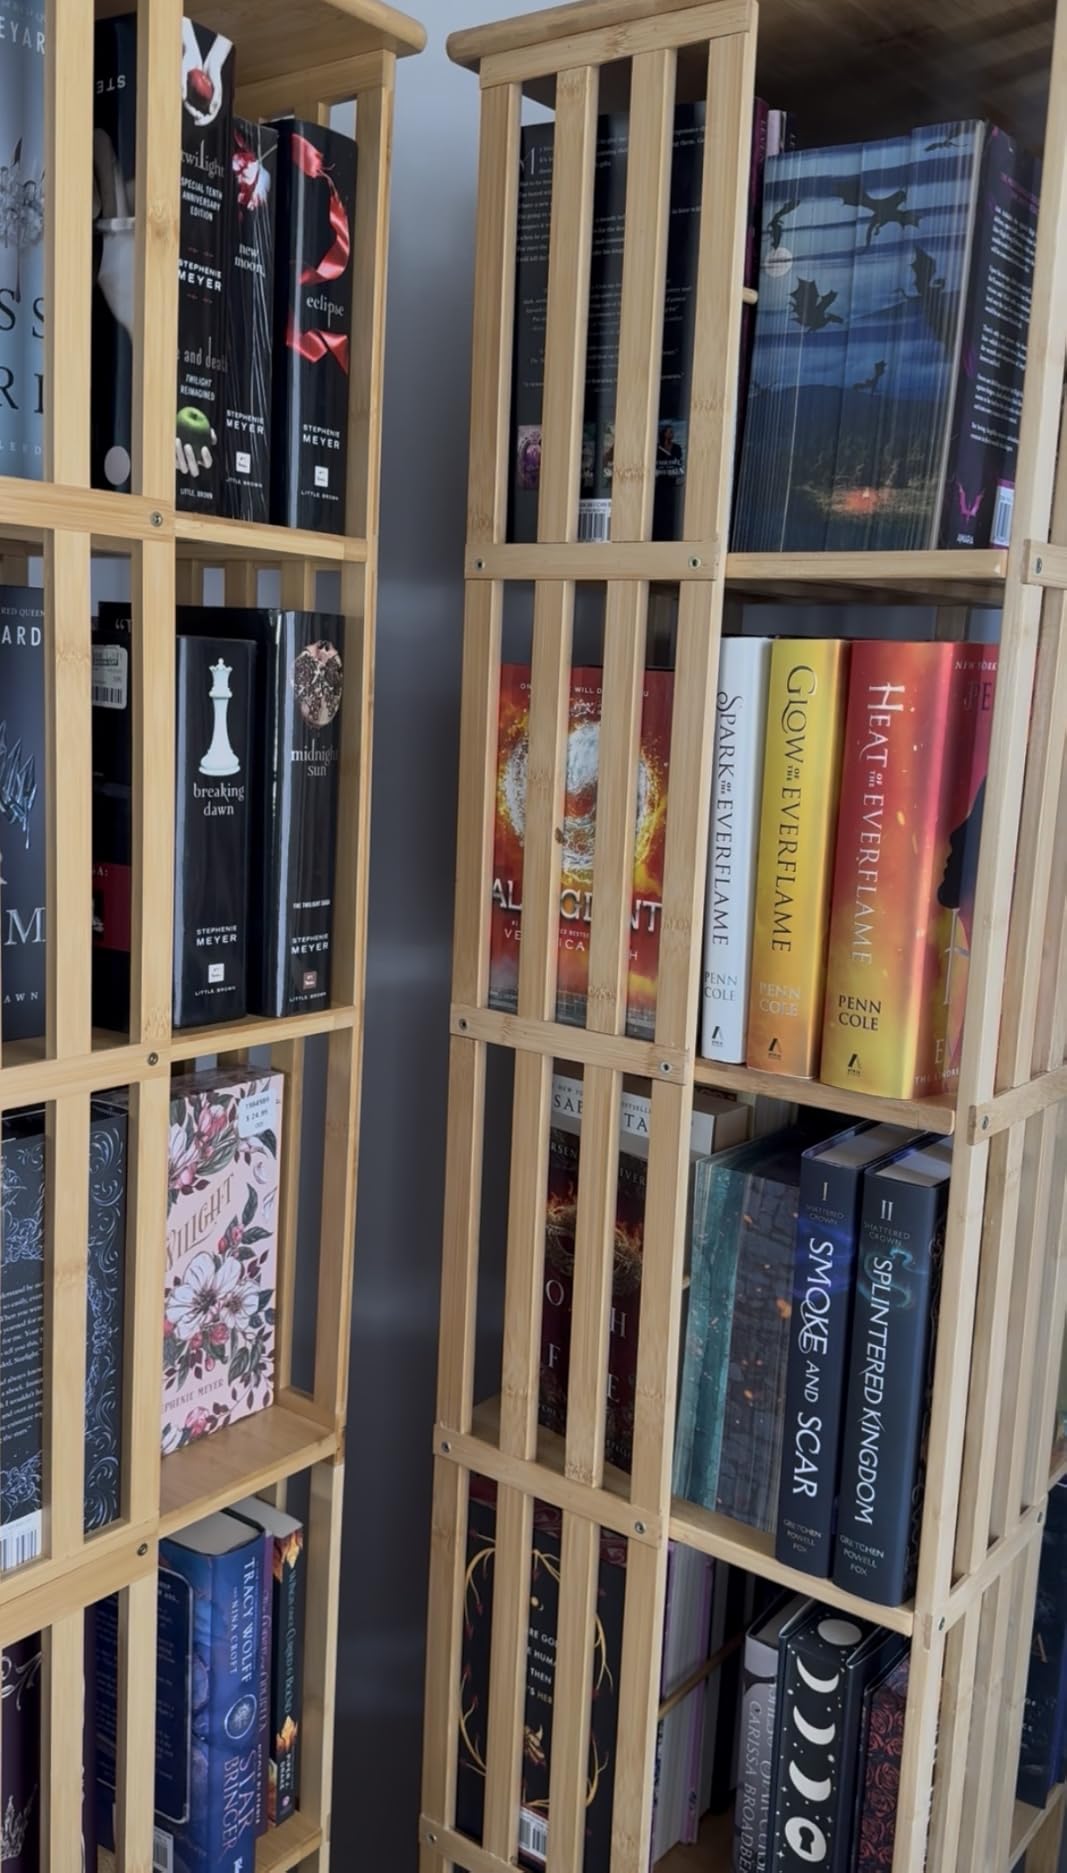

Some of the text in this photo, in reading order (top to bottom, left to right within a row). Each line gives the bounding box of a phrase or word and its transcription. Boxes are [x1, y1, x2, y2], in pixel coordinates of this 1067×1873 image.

[182, 190, 221, 211] ANNIVERSARY
[190, 205, 213, 221] EDITION
[239, 243, 260, 258] new
[179, 258, 222, 279] STEPHENIE
[178, 269, 222, 292] MEYER
[305, 293, 346, 328] eclipse
[184, 347, 203, 366] and
[226, 409, 264, 425] STEPHENIE
[226, 418, 264, 436] MEYER
[303, 424, 340, 438] STEPHENIE
[303, 433, 340, 450] MEYER
[574, 686, 595, 695] WILL
[781, 665, 818, 763] GLOW
[717, 691, 744, 779] SPARK
[307, 765, 327, 777] sun
[794, 767, 800, 780] OF
[193, 782, 245, 802] breaking
[726, 781, 732, 793] OF
[203, 801, 235, 817] dawn
[852, 682, 906, 965] HEAT OF THE EVERFLAME
[711, 800, 734, 945] EVERFLAME
[772, 787, 802, 952] EVERFLAME
[196, 925, 238, 936] STEPHENIE
[291, 933, 329, 945] STEPHENIE
[196, 934, 238, 947] MEYER
[291, 942, 329, 955] MEYER
[704, 970, 737, 987] PENN
[704, 986, 736, 1001] COLE
[759, 981, 801, 999] PENN
[759, 998, 799, 1017] COLE
[838, 994, 882, 1014] PENN
[838, 1012, 879, 1031] COLE
[822, 1182, 828, 1200] I
[880, 1200, 894, 1222] II
[863, 1221, 910, 1241] SHATTERED
[868, 1231, 903, 1248] CROWN
[792, 1237, 834, 1498] SMOKE AND SCAR
[854, 1257, 894, 1525] SPLINTERED KINGDOM
[783, 1518, 822, 1539] GRETCHEN
[787, 1529, 816, 1547] POWELL
[792, 1542, 808, 1553] FOX
[840, 1534, 885, 1559] GRETCHEN
[843, 1549, 877, 1569] POWELL
[850, 1563, 868, 1577] FOX
[242, 1556, 256, 1618] TRACY
[231, 1599, 240, 1632] NINA
[229, 1635, 239, 1674] CROFT
[240, 1623, 253, 1683] WOLFF
[744, 1699, 763, 1775] CARISSA
[238, 1750, 257, 1837] STAR
[217, 1755, 241, 1863] BRINGER
